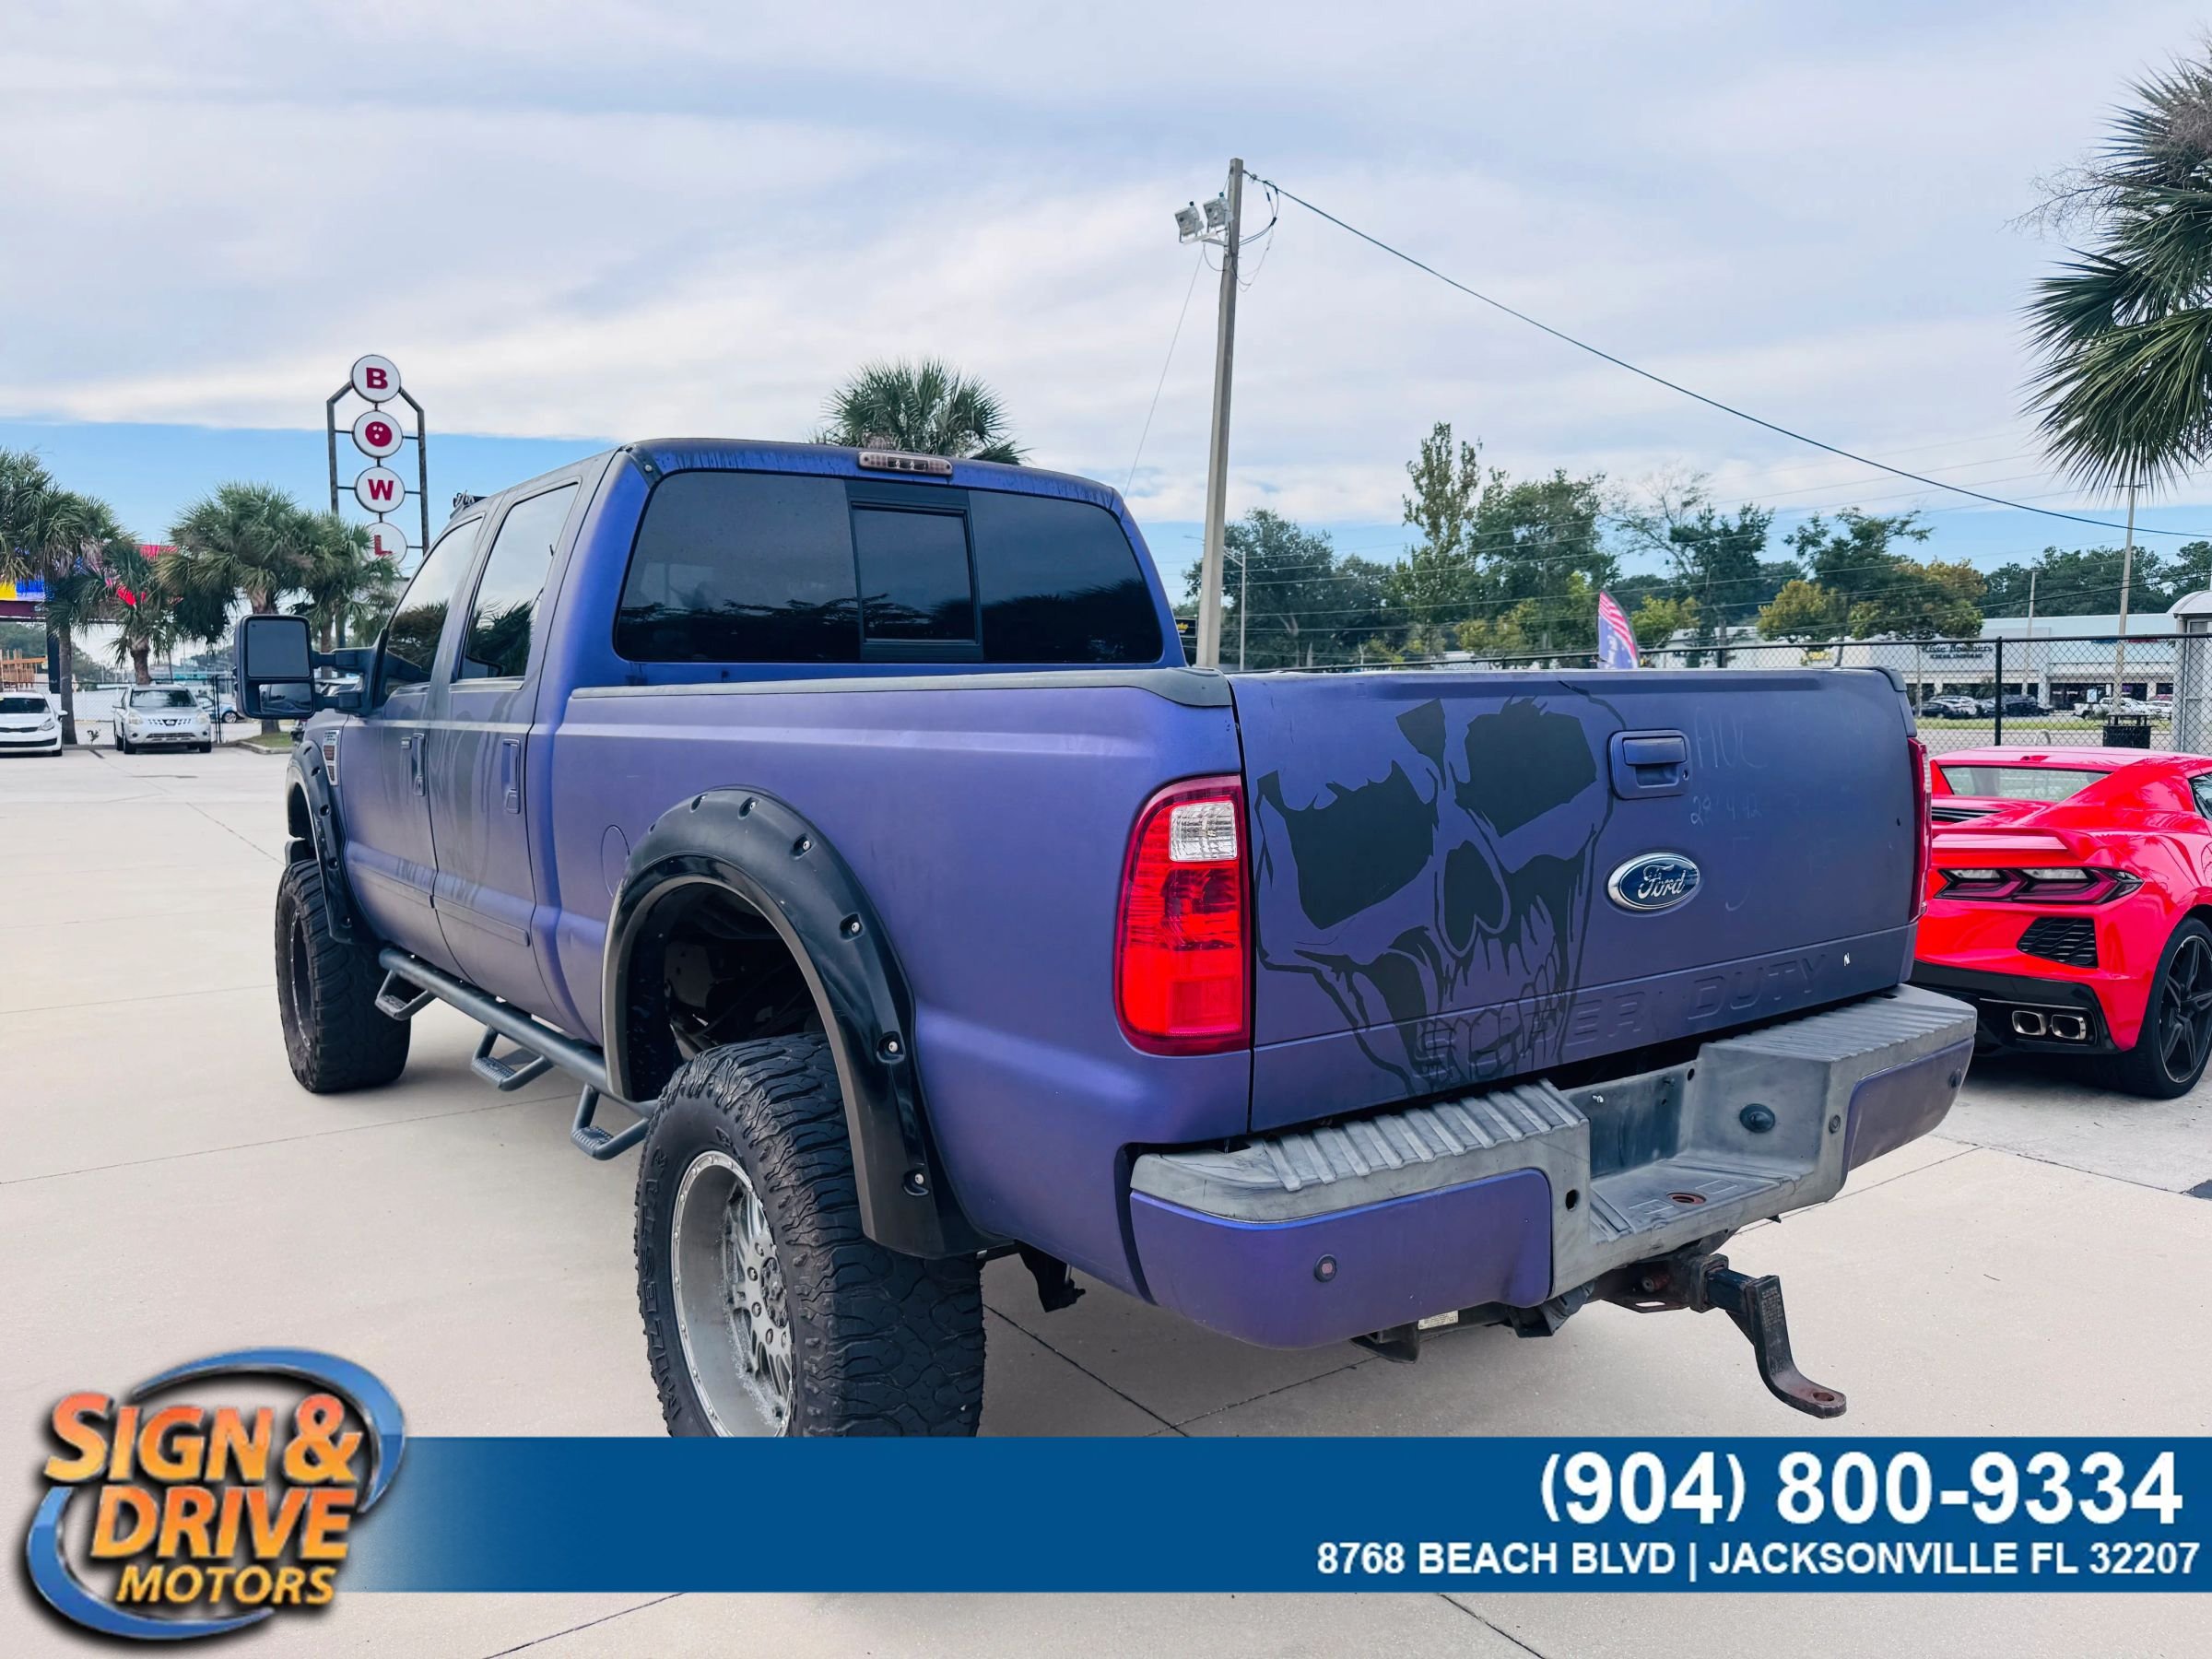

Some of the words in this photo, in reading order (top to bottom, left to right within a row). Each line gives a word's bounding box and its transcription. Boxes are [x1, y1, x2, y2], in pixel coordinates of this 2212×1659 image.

[1637, 864, 1687, 900] Ford
[1412, 991, 1648, 1079] SUPER
[1687, 954, 1828, 1021] DUTY
